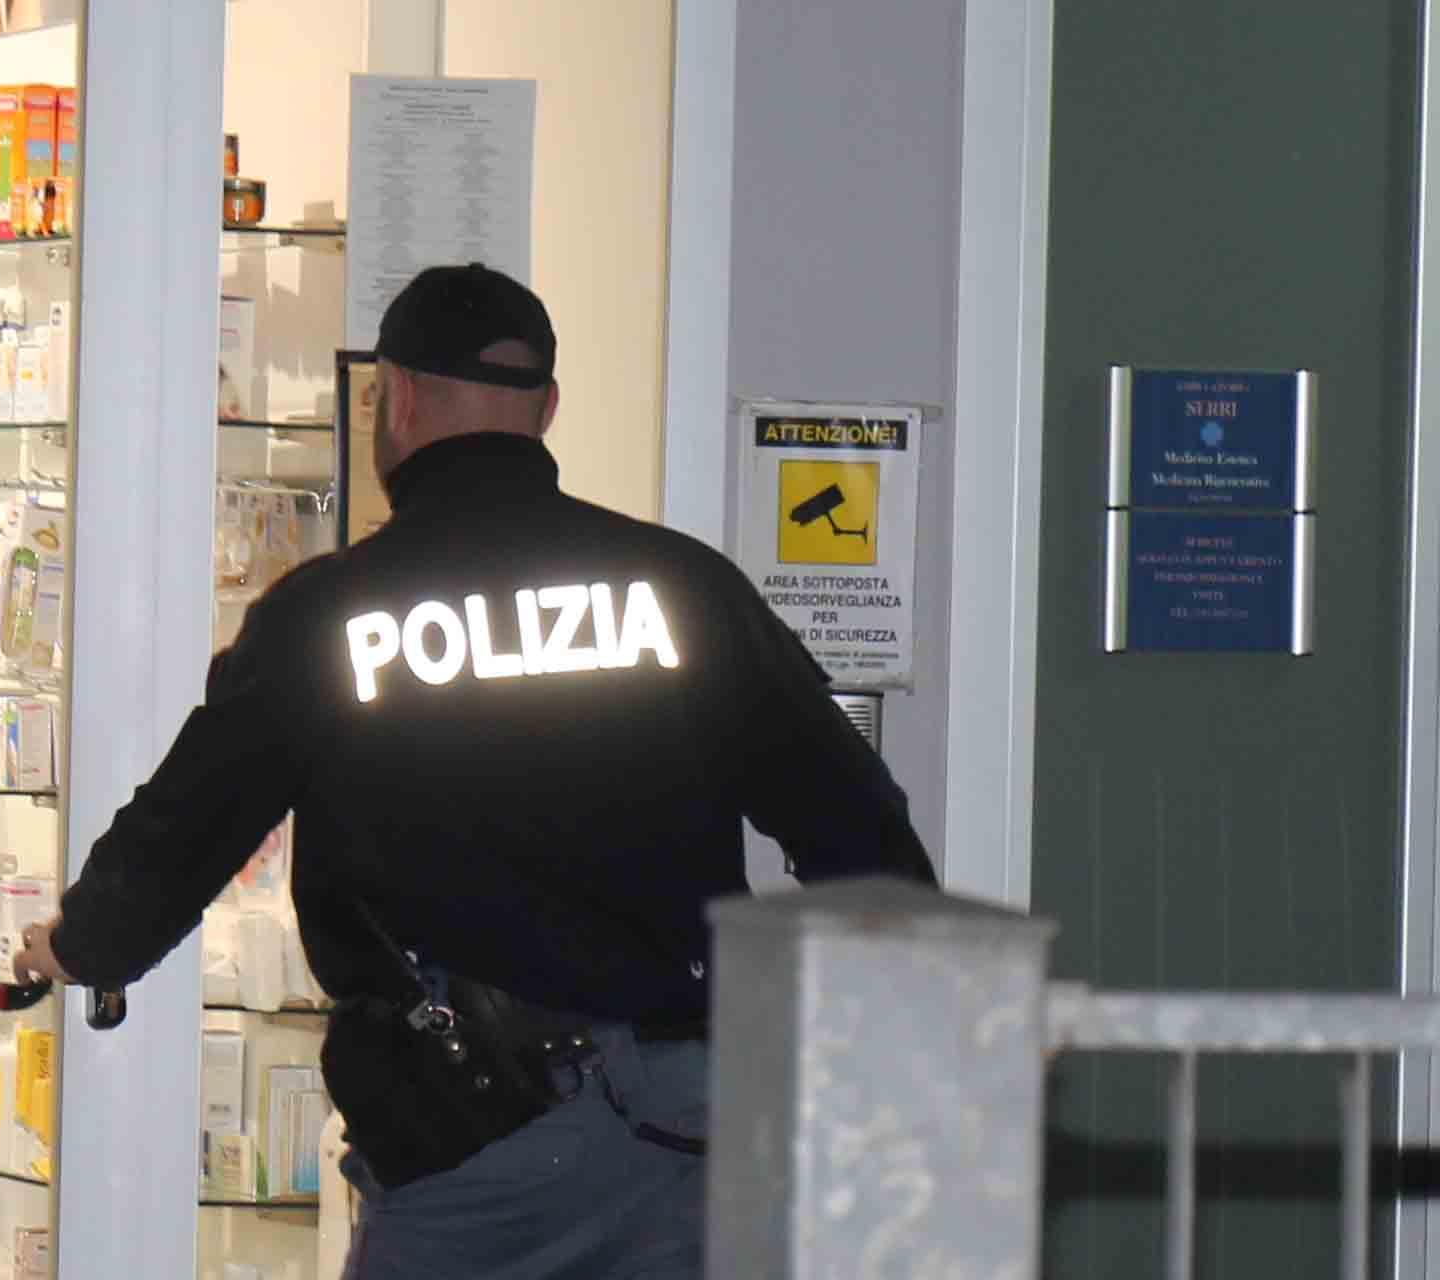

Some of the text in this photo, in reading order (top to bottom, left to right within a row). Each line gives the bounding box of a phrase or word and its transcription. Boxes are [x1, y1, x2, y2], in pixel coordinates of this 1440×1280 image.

[764, 422, 898, 445] ATTENZIONE!
[763, 575, 889, 590] AREA SOTTOPOSTA
[812, 610, 839, 624] PER
[345, 581, 680, 703] POLIZIA
[810, 628, 823, 641] DI
[825, 629, 898, 643] SICUREZZA
